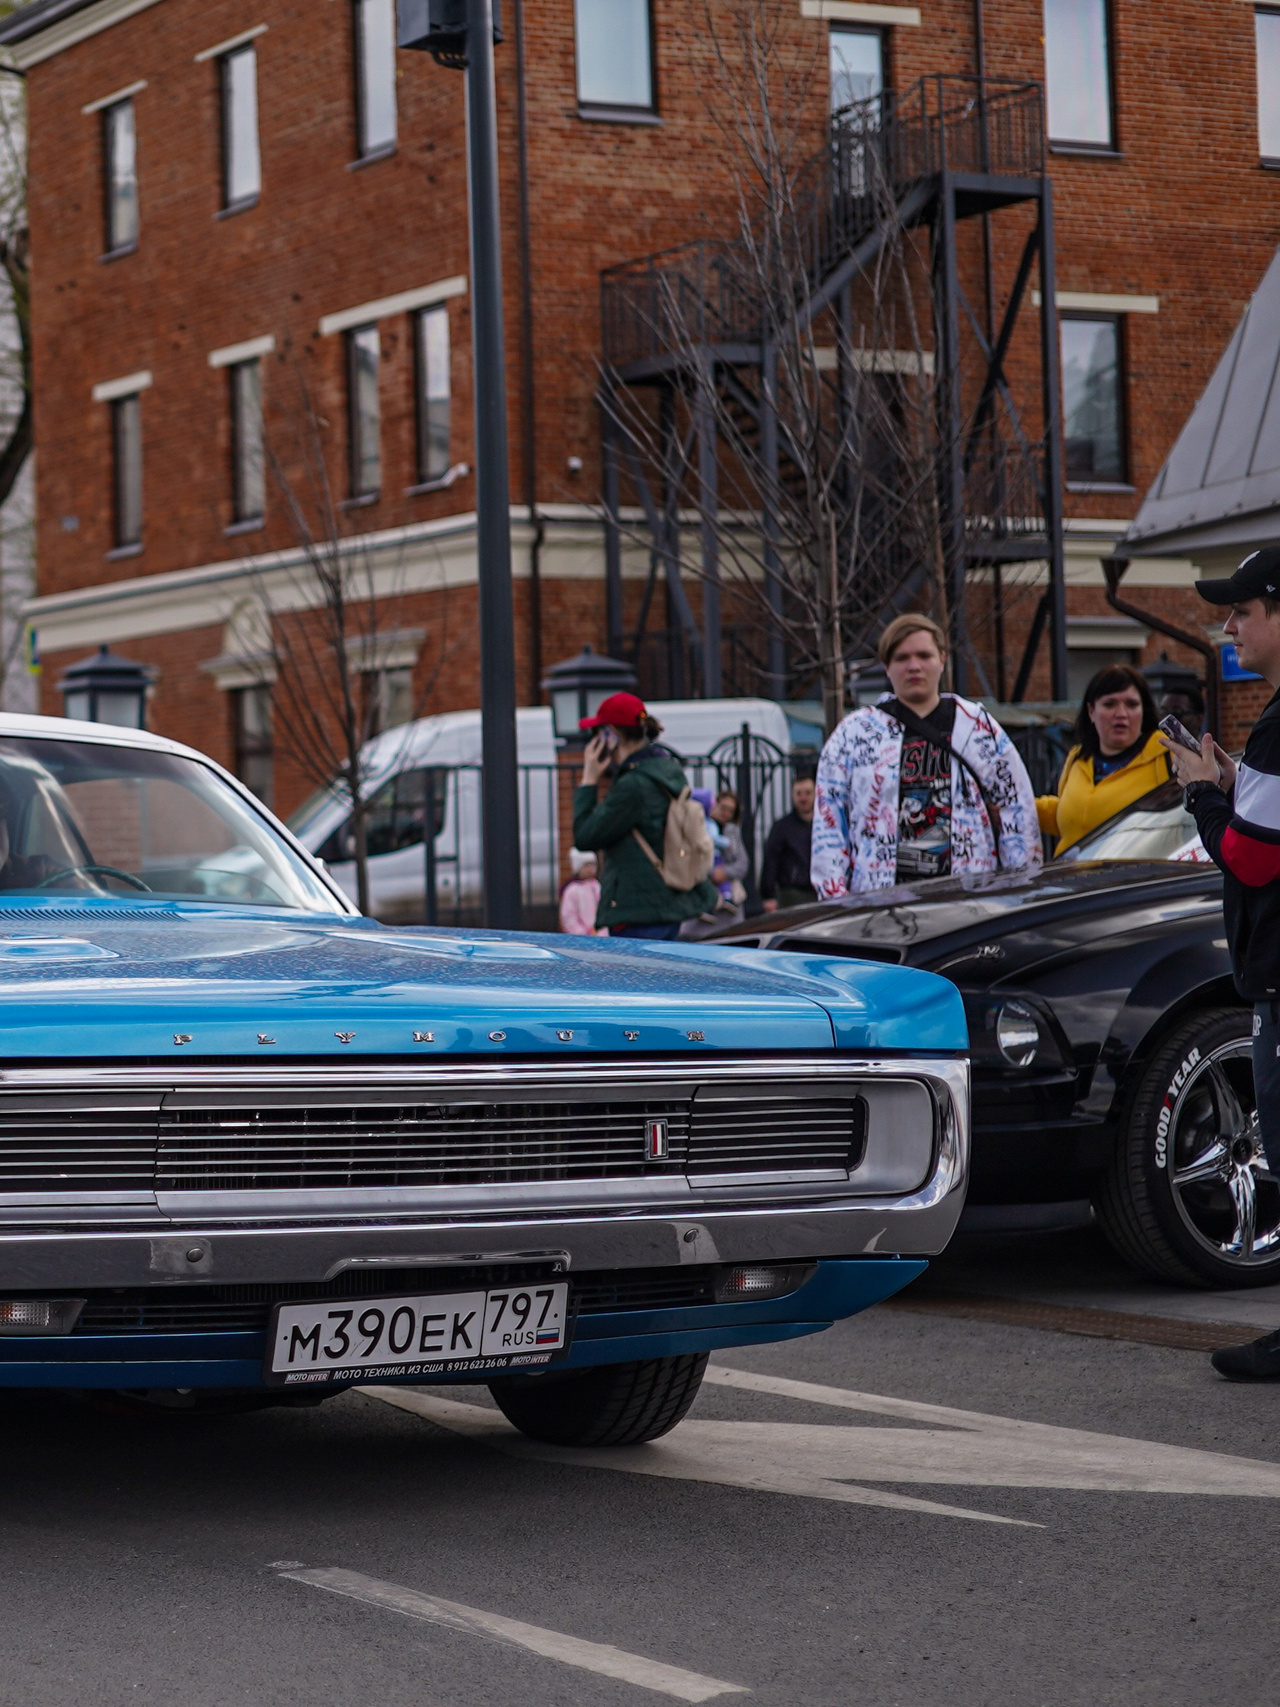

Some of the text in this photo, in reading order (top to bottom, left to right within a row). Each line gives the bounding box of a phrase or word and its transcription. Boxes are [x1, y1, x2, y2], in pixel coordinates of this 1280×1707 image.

[173, 1030, 707, 1046] PLYMOUTH
[489, 1290, 555, 1333] 797
[502, 1333, 535, 1347] RUS
[364, 1366, 406, 1378] ТЕХНИКА
[408, 1364, 421, 1375] ИЗ
[422, 1363, 445, 1374] США
